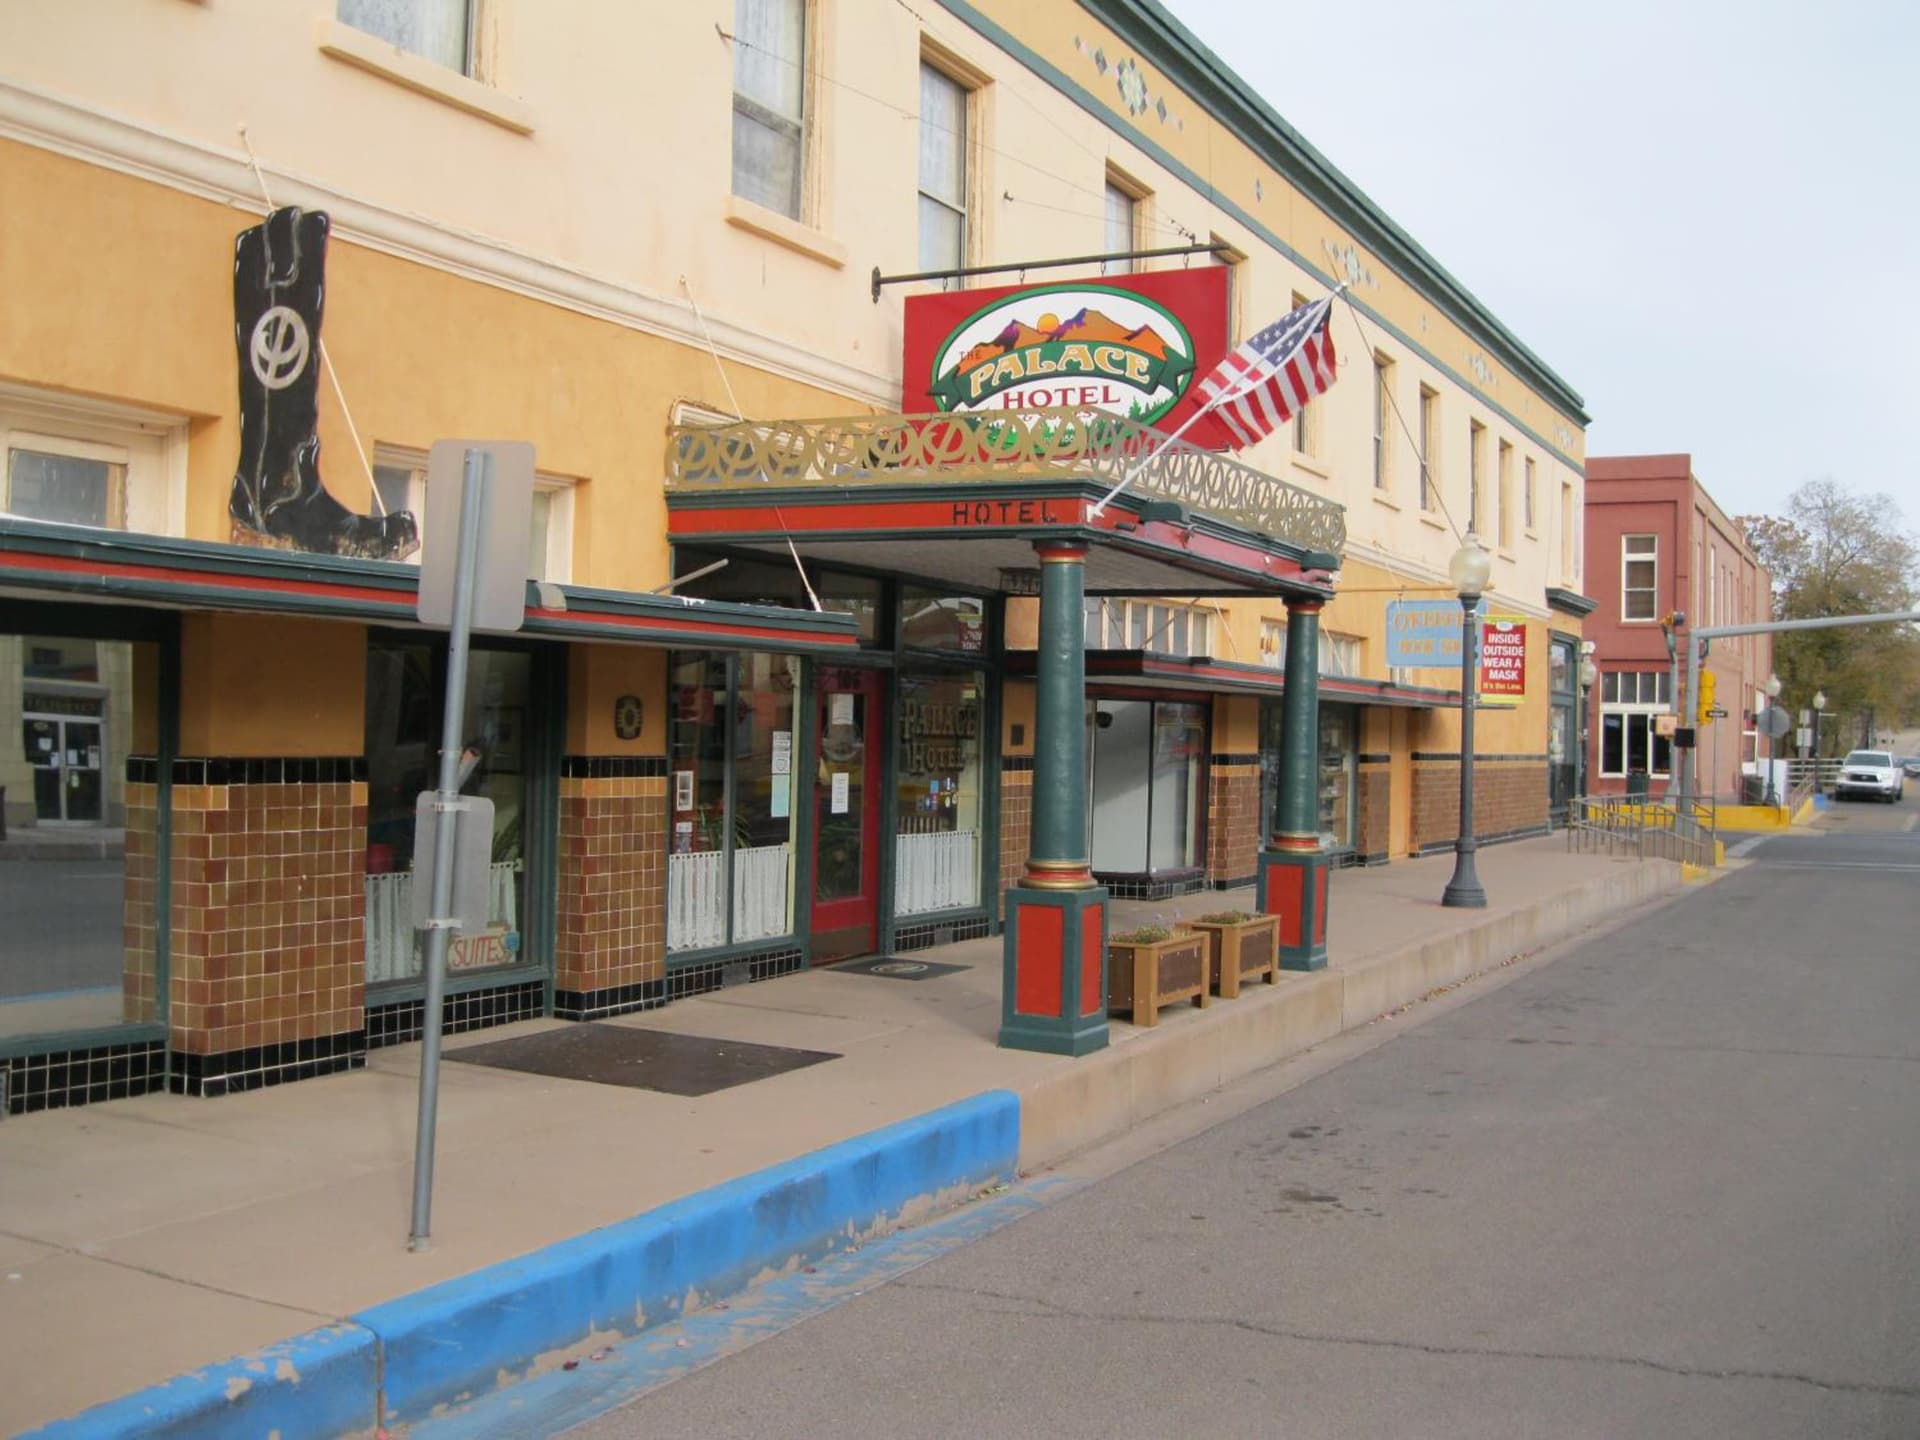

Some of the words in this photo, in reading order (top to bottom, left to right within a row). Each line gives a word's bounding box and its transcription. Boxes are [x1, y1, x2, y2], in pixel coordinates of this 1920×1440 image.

[959, 350, 982, 361] THE
[969, 344, 1150, 398] PALACE
[1003, 385, 1121, 409] HOTEL
[953, 501, 1057, 525] HOTEL
[1483, 645, 1525, 656] OUTSIDE
[1487, 633, 1521, 645] INSIDE
[1483, 657, 1513, 668] WEAR
[1514, 658, 1522, 668] A
[1488, 669, 1519, 680] MASK
[902, 698, 976, 739] PALACE
[906, 741, 966, 773] HOTEL
[453, 934, 507, 967] SUITES
